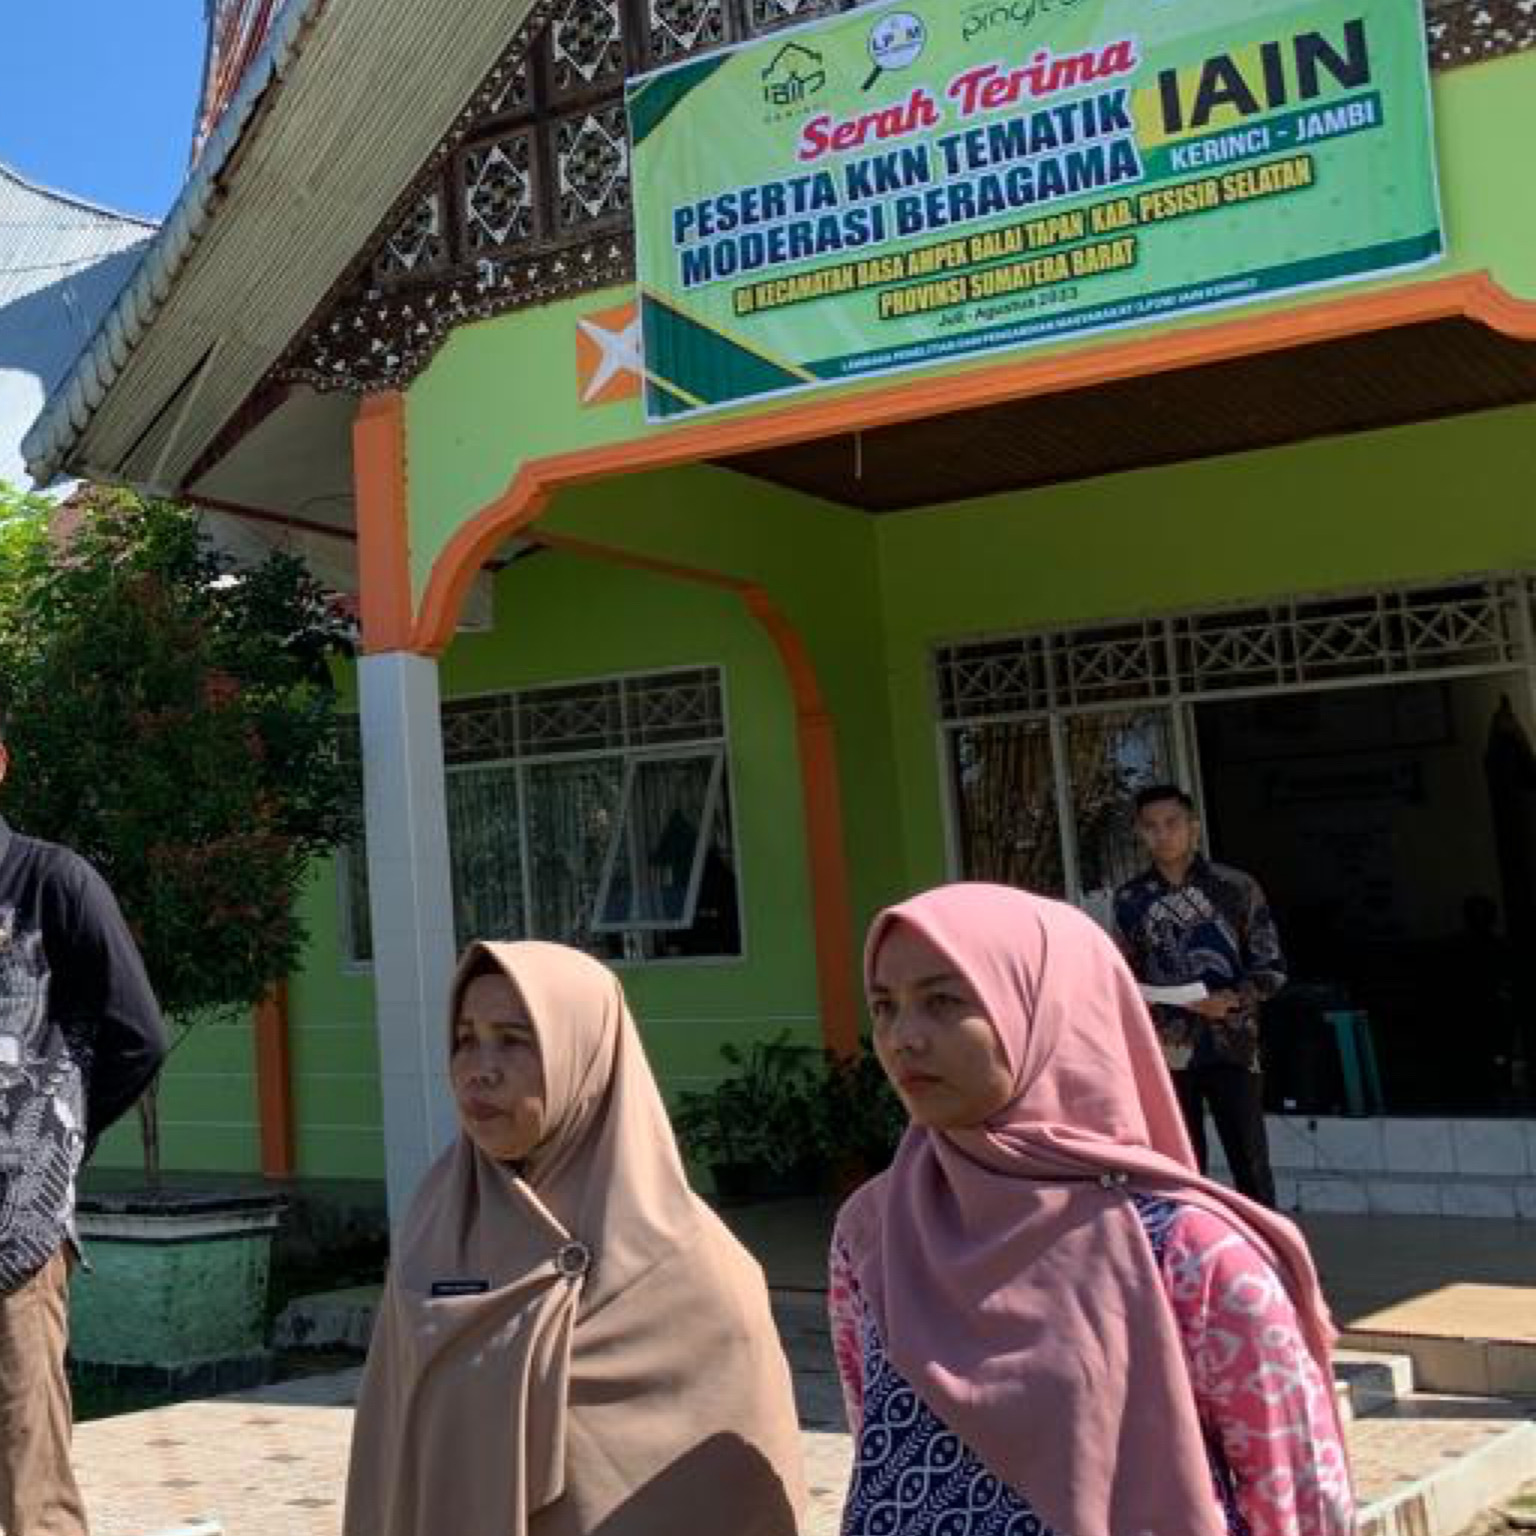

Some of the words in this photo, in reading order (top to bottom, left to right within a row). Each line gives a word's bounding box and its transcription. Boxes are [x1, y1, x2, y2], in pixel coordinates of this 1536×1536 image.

[799, 89, 938, 161] Serah
[949, 41, 1136, 115] Terima
[1158, 18, 1371, 134] IAIN
[1172, 128, 1269, 171] KERINCI
[1296, 101, 1375, 141] JAMBI
[674, 171, 837, 243] PESERTA
[846, 145, 929, 200] KKN
[938, 89, 1131, 174] TEMATIK
[681, 203, 885, 287] MODERASI
[896, 138, 1139, 236] BERAGAMA
[756, 264, 856, 306] KECAMATAN
[858, 254, 903, 287] BASA
[909, 239, 966, 275] AMPEK
[971, 227, 1023, 261] BALAI
[1028, 211, 1084, 248] TAPAN
[1140, 179, 1218, 221] PESISIR
[1222, 157, 1310, 200] SELATAN
[882, 275, 966, 317] PROVINSI
[971, 255, 1068, 298] SUMATERA
[1072, 239, 1134, 276] BARAT
